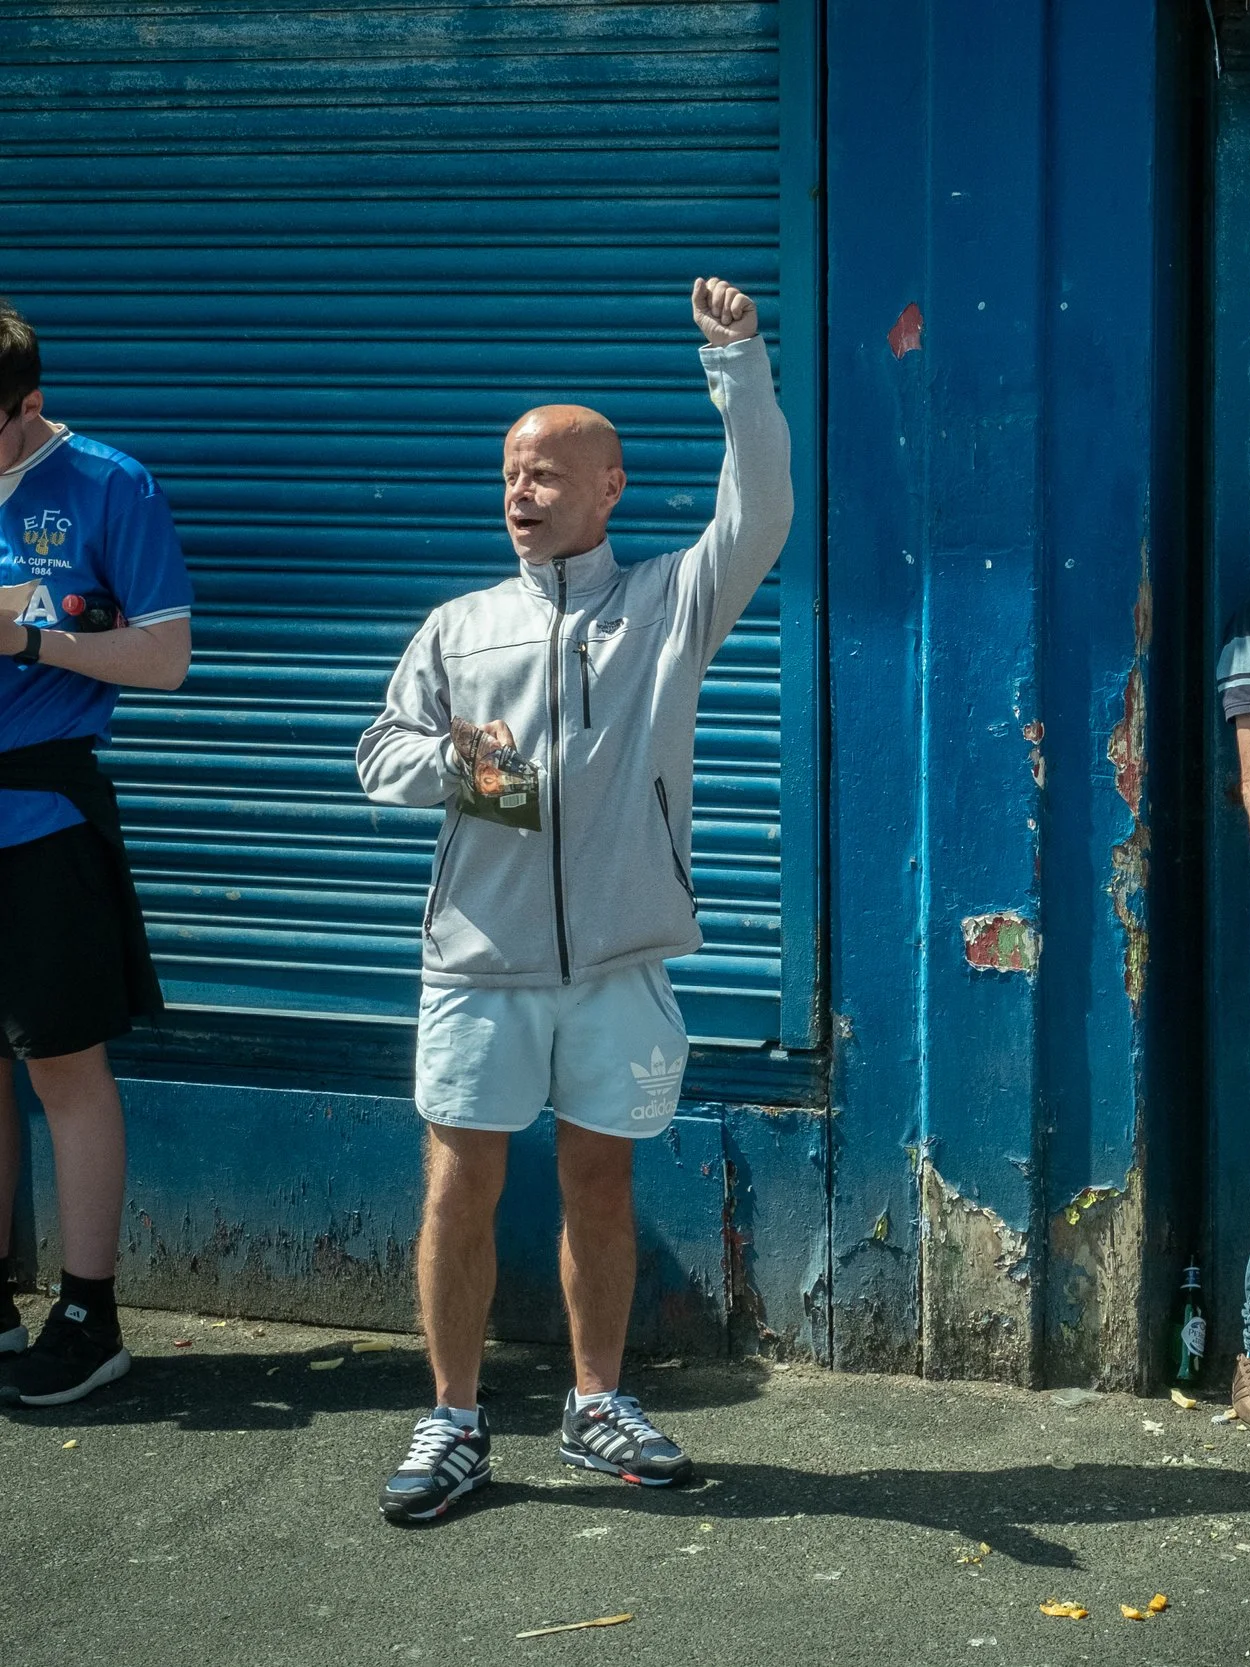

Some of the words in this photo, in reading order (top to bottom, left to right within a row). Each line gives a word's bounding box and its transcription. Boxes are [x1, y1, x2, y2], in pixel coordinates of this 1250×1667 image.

[23, 509, 72, 533] EFC
[27, 556, 47, 567] CUP
[47, 558, 72, 569] FINAL
[31, 567, 52, 576] 1984
[14, 585, 58, 625] A
[631, 1097, 678, 1120] adidas
